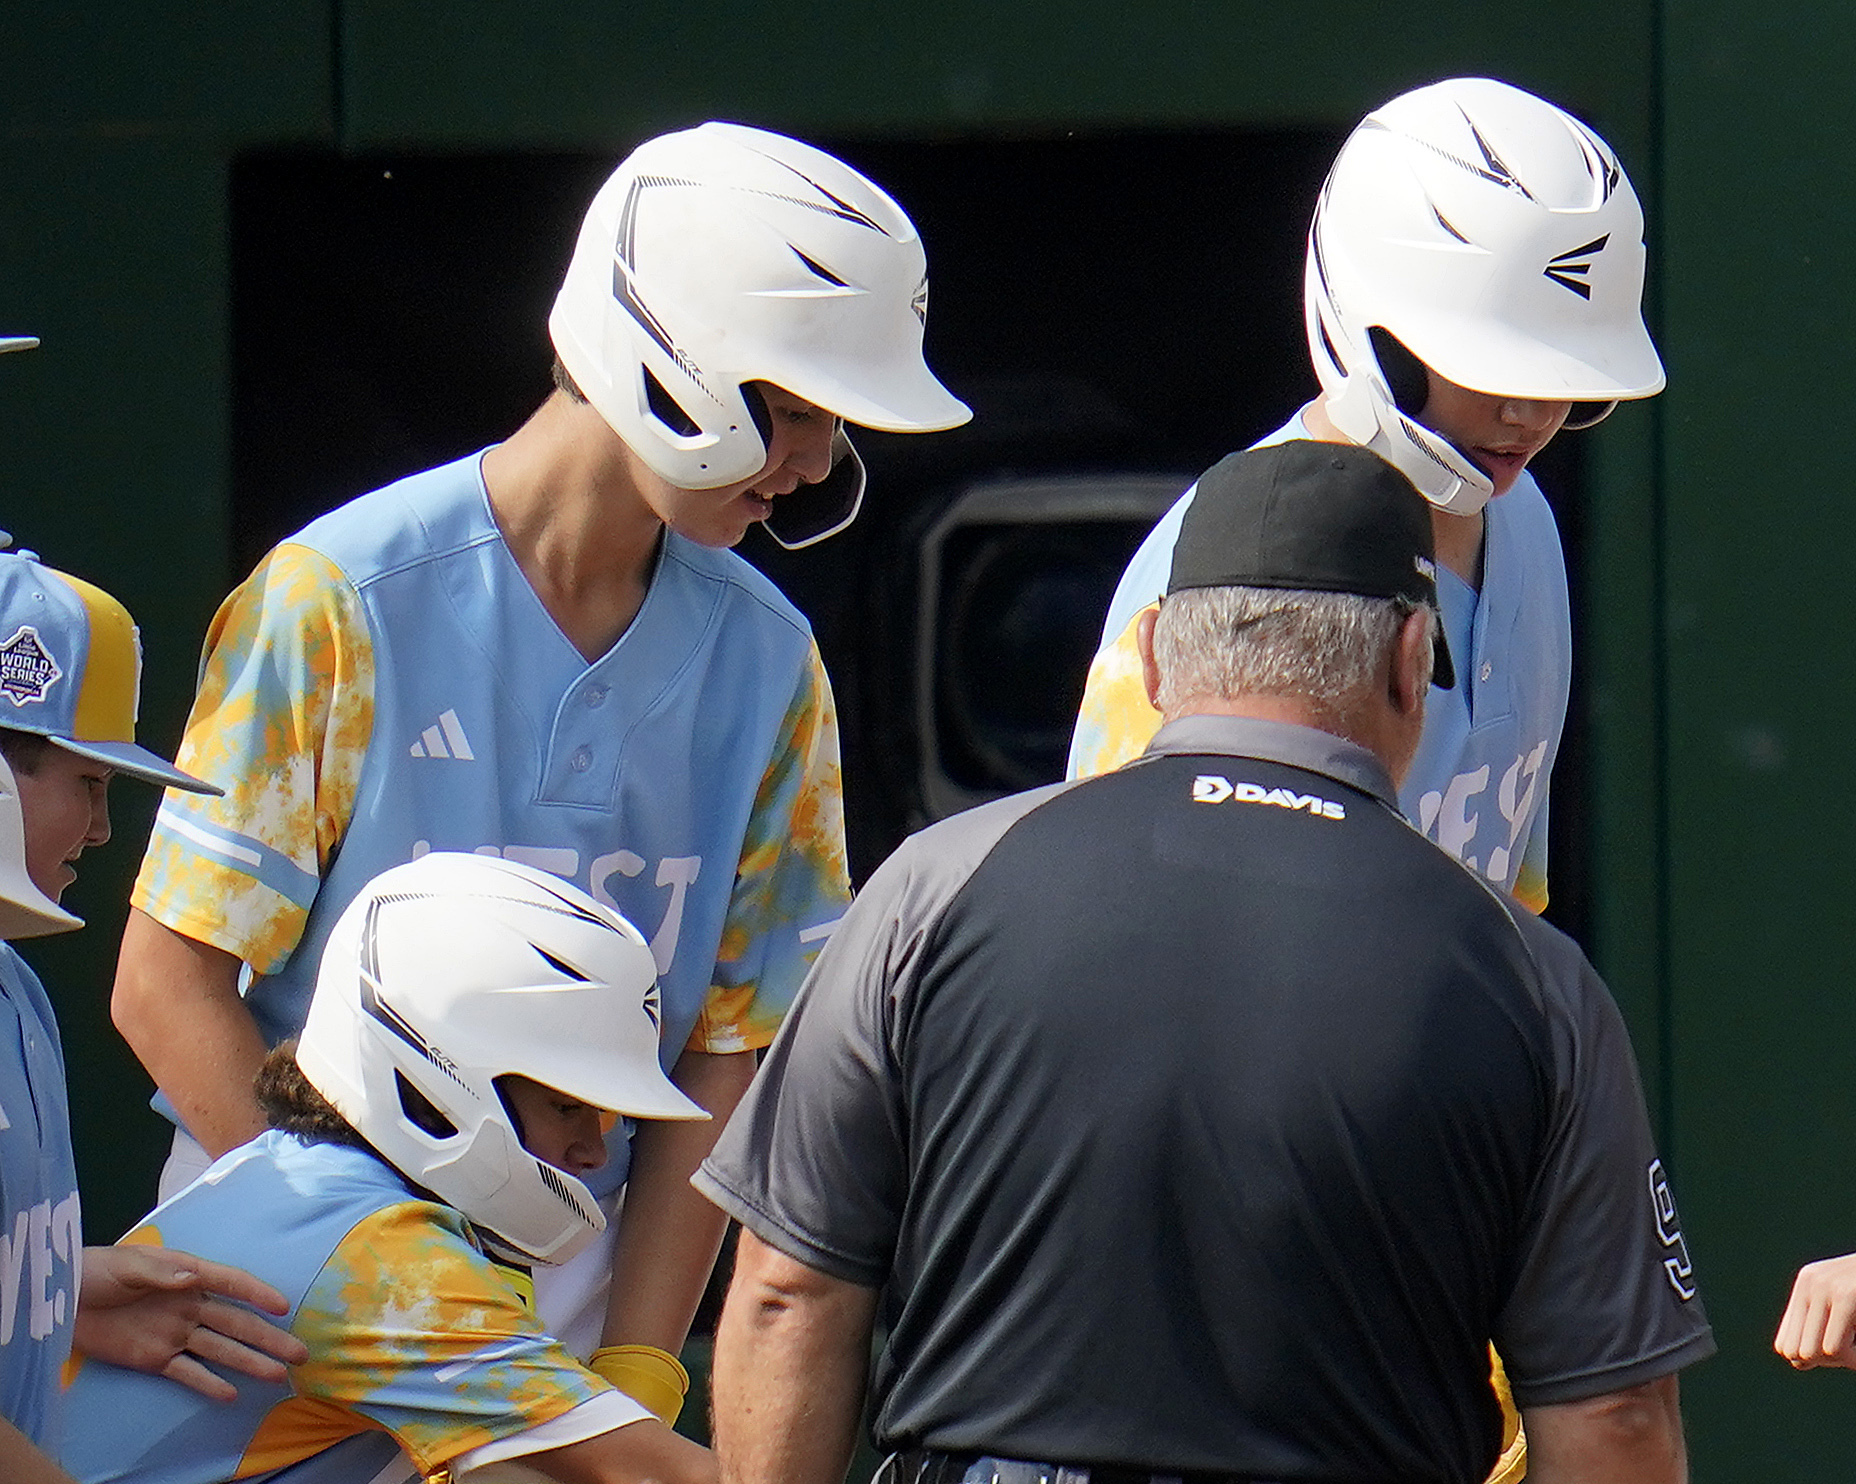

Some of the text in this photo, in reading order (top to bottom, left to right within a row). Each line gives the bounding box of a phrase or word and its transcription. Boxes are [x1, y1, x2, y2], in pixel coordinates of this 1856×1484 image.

[1, 653, 49, 673] WORLD
[2, 666, 45, 686] SERIES
[1234, 782, 1346, 820] DAVIS
